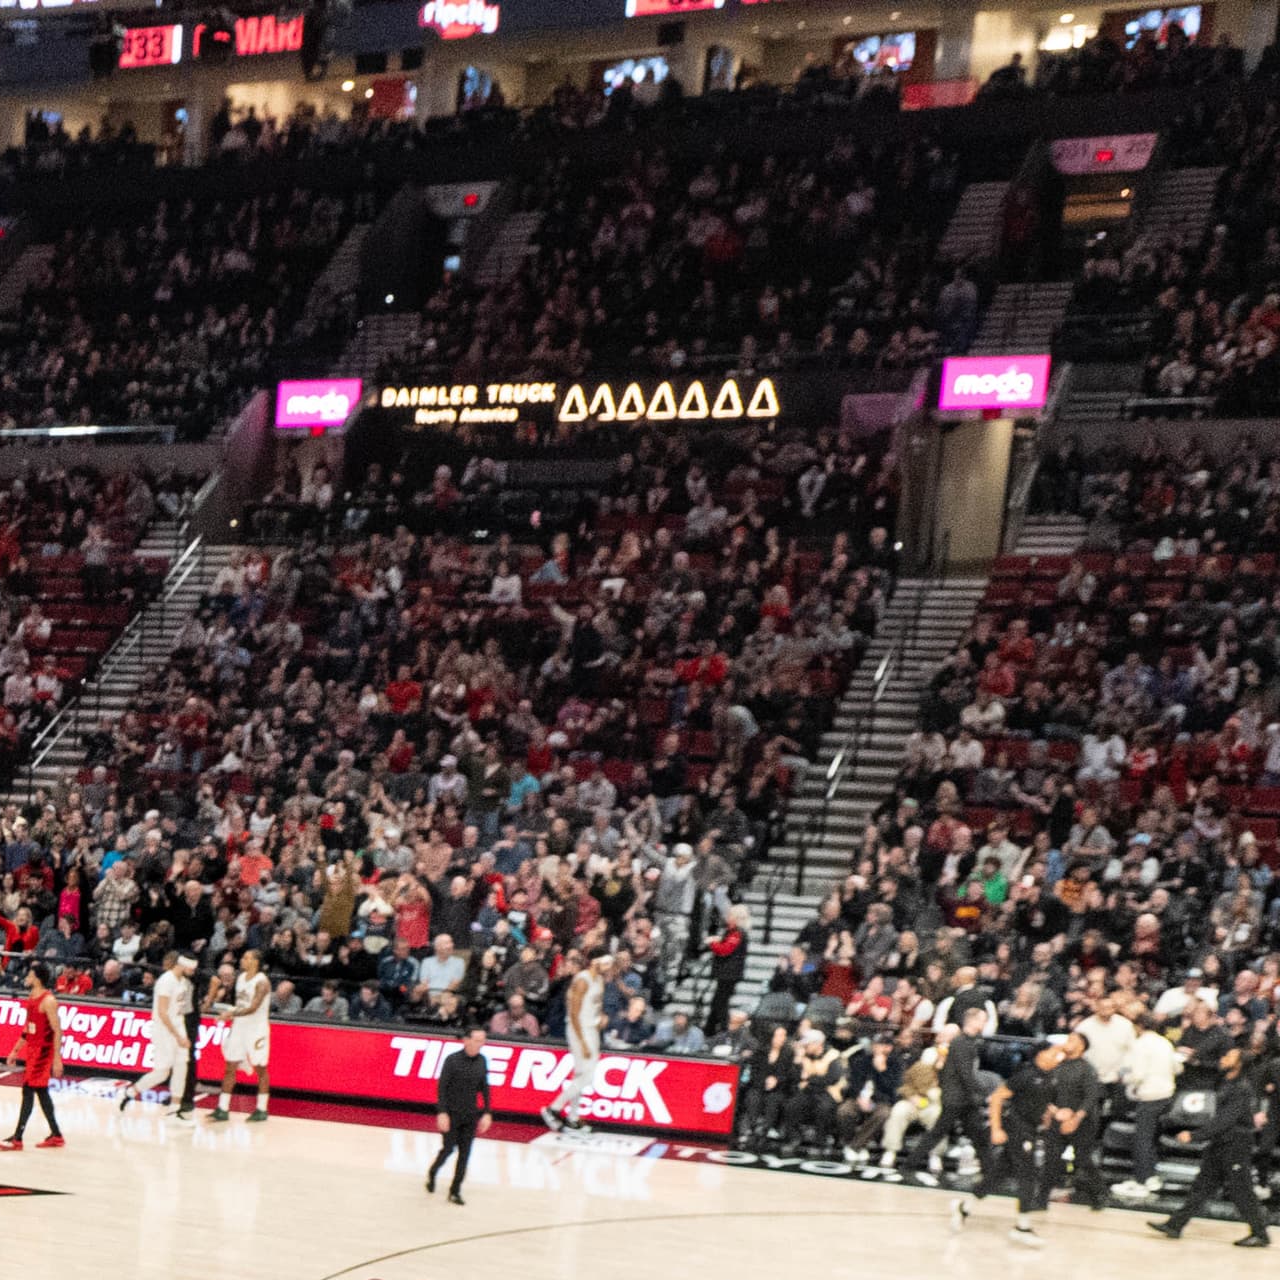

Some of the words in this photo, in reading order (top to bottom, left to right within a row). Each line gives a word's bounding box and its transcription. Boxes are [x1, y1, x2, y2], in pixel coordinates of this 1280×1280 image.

[953, 365, 1034, 394] moda
[381, 385, 477, 408] DAIMLER
[487, 382, 556, 405] TRUCK
